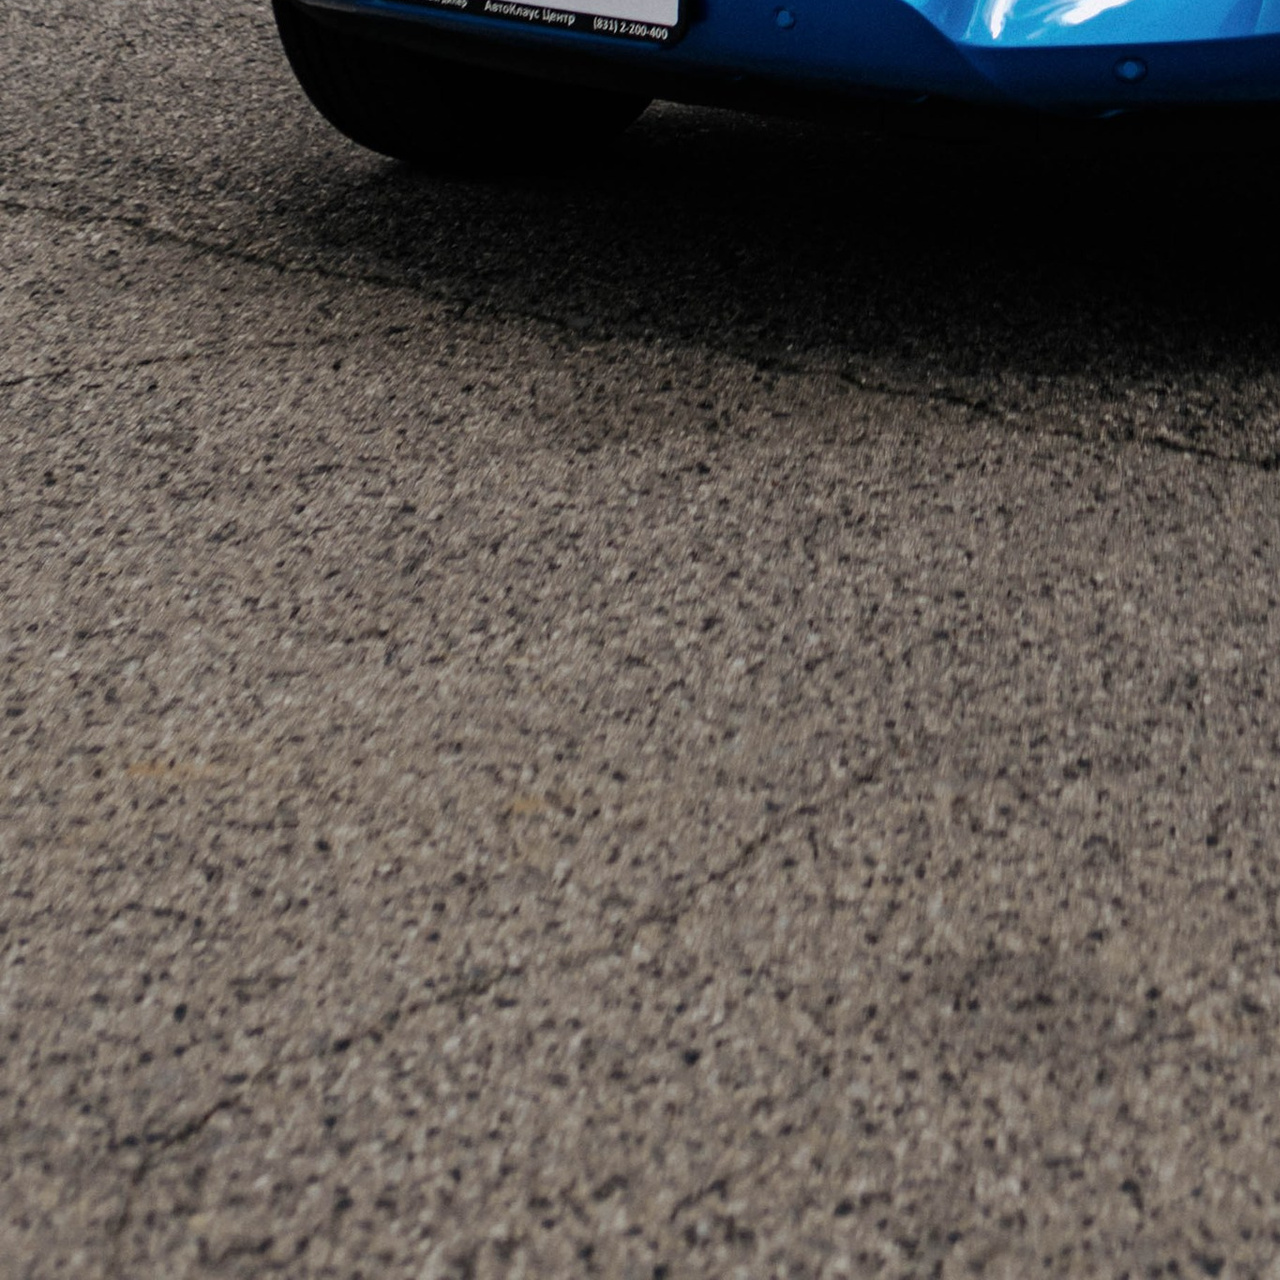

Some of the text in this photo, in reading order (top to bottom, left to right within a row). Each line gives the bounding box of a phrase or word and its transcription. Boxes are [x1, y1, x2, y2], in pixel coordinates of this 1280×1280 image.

[484, 0, 540, 20] АвтоКлаус
[542, 7, 576, 27] Центр
[593, 16, 618, 33] (831)
[619, 22, 669, 40] 2-200-400
